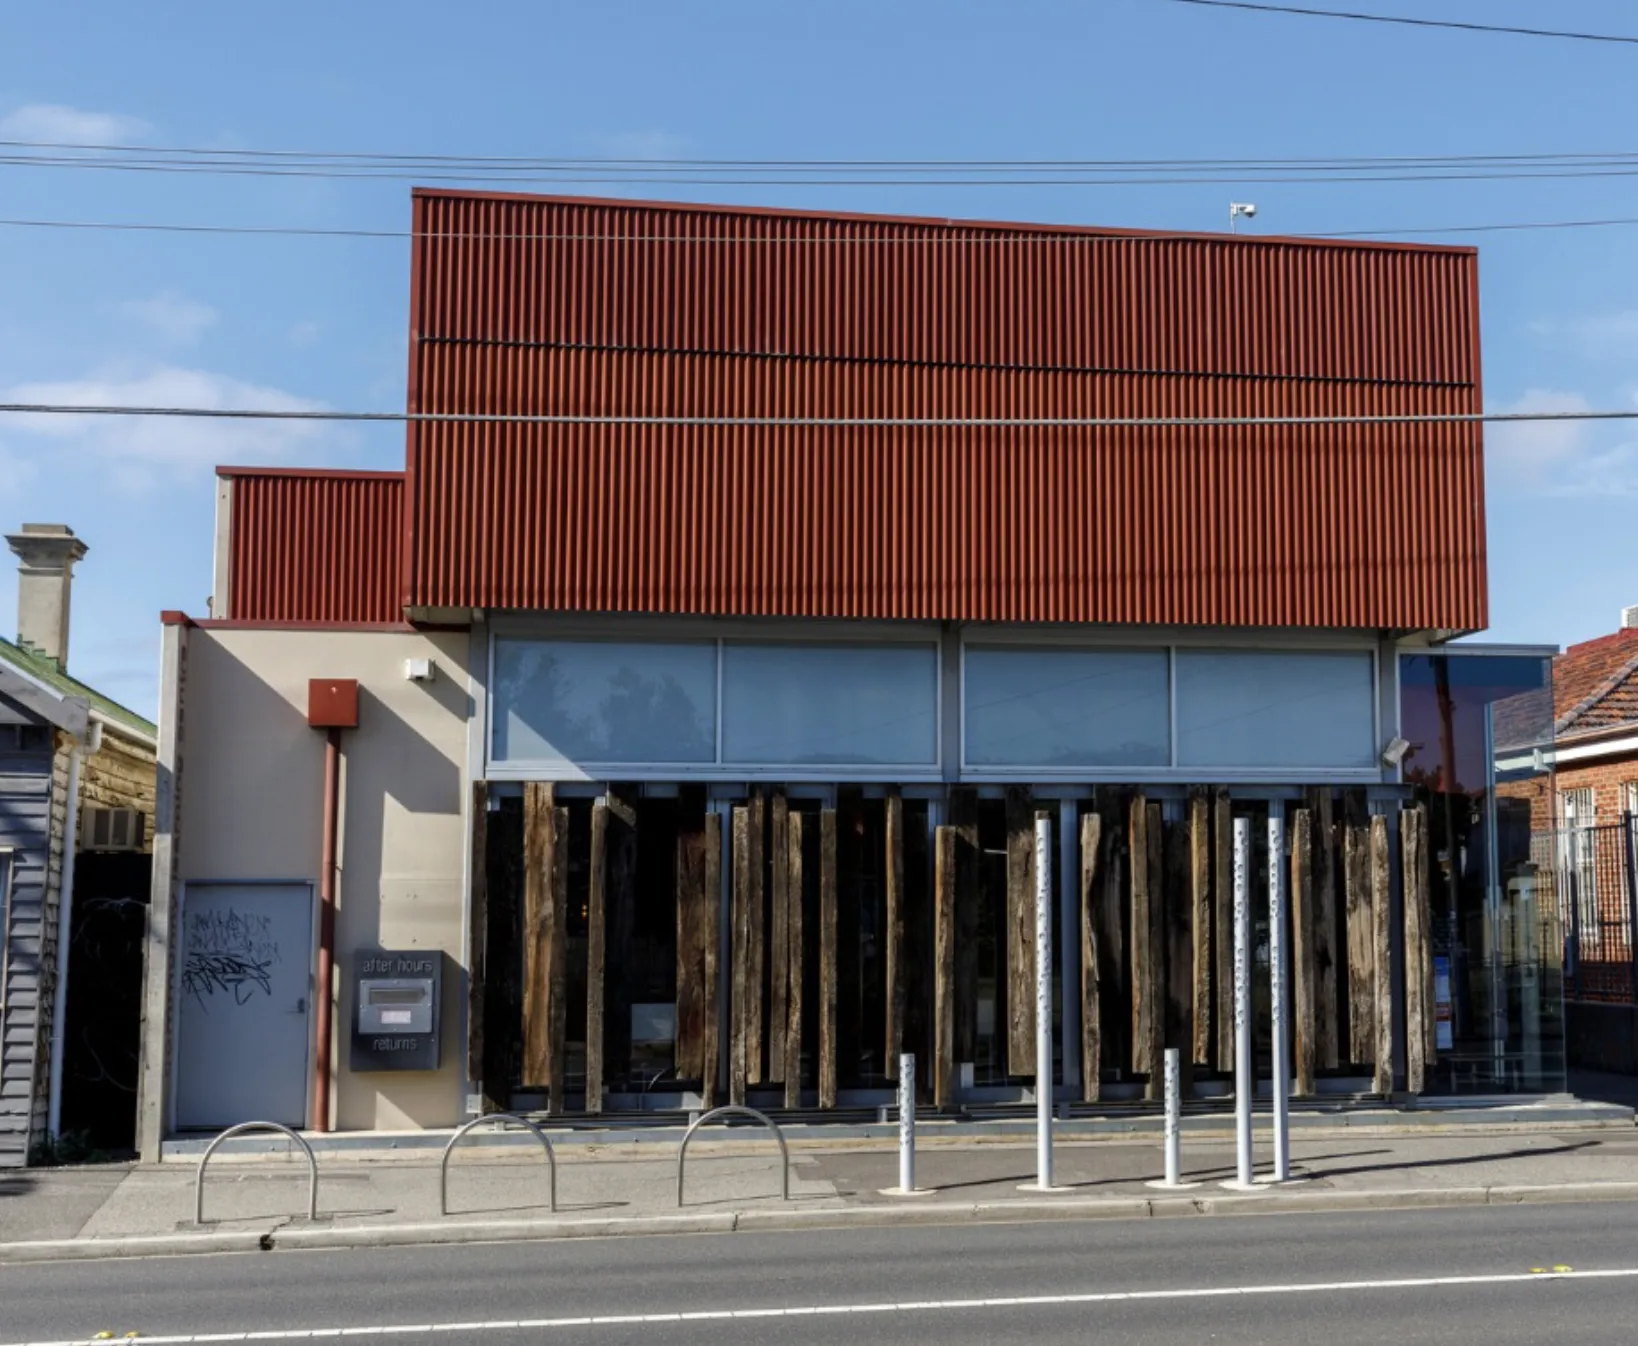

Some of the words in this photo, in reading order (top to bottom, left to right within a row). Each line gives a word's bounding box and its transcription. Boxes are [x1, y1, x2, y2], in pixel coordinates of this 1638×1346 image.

[363, 958, 393, 972] after
[397, 958, 433, 972] hours
[374, 1036, 417, 1051] returns
